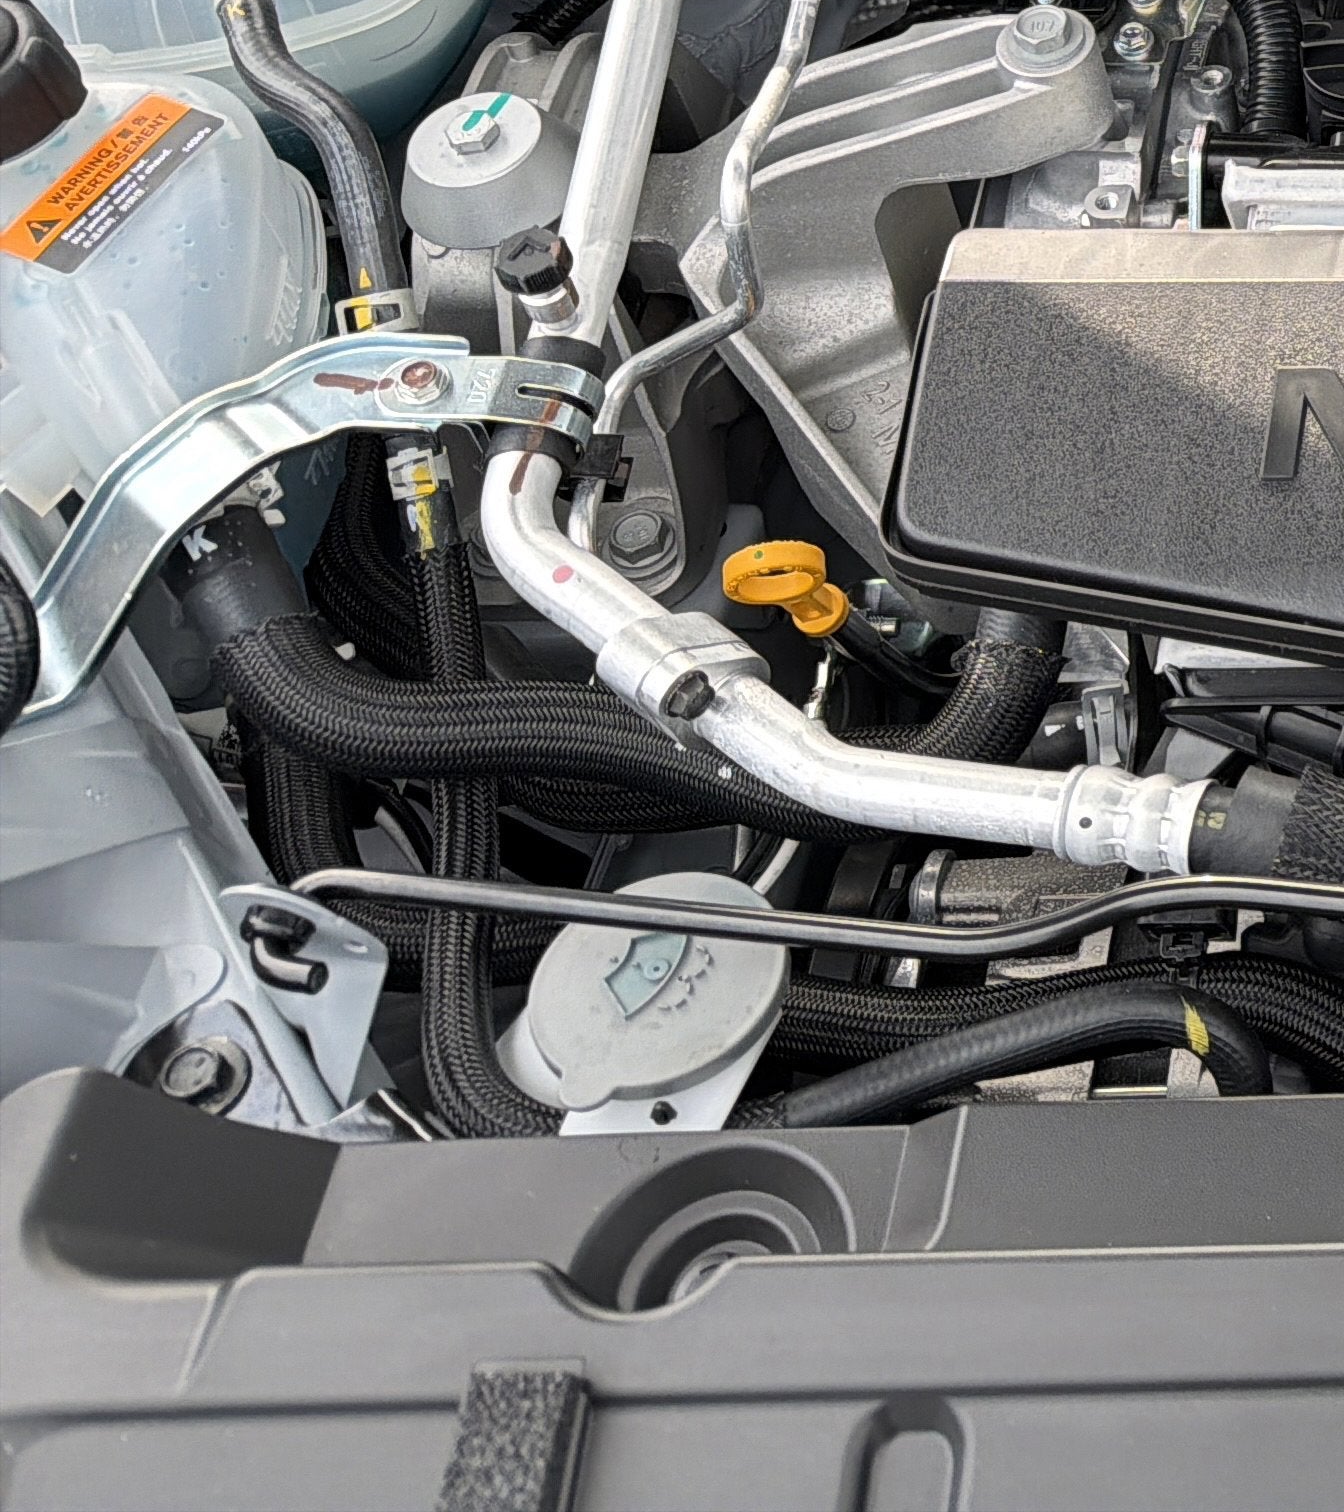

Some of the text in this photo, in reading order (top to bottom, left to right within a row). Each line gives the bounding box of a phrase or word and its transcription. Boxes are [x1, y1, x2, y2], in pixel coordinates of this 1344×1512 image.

[47, 146, 114, 206] WARNING
[65, 112, 171, 213] AVERTISSEMENT
[183, 524, 219, 563] K
